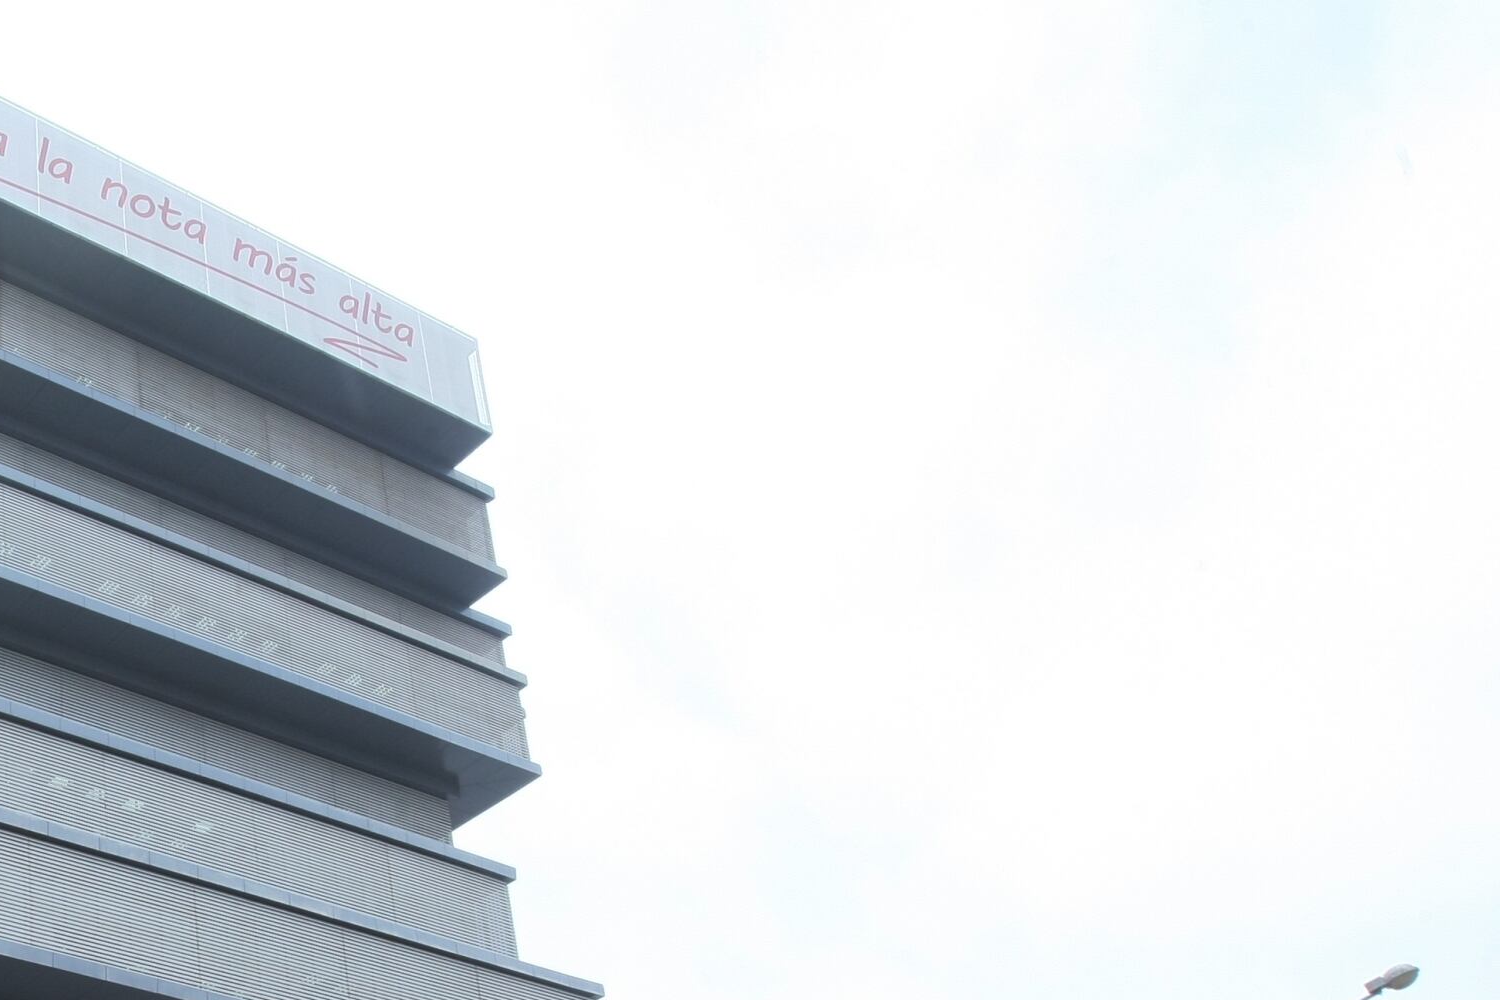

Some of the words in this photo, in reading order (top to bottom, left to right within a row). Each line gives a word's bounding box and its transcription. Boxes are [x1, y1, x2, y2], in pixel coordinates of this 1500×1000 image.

[37, 138, 74, 184] la
[100, 176, 207, 244] nota
[232, 234, 317, 297] más
[338, 290, 415, 348] alta
